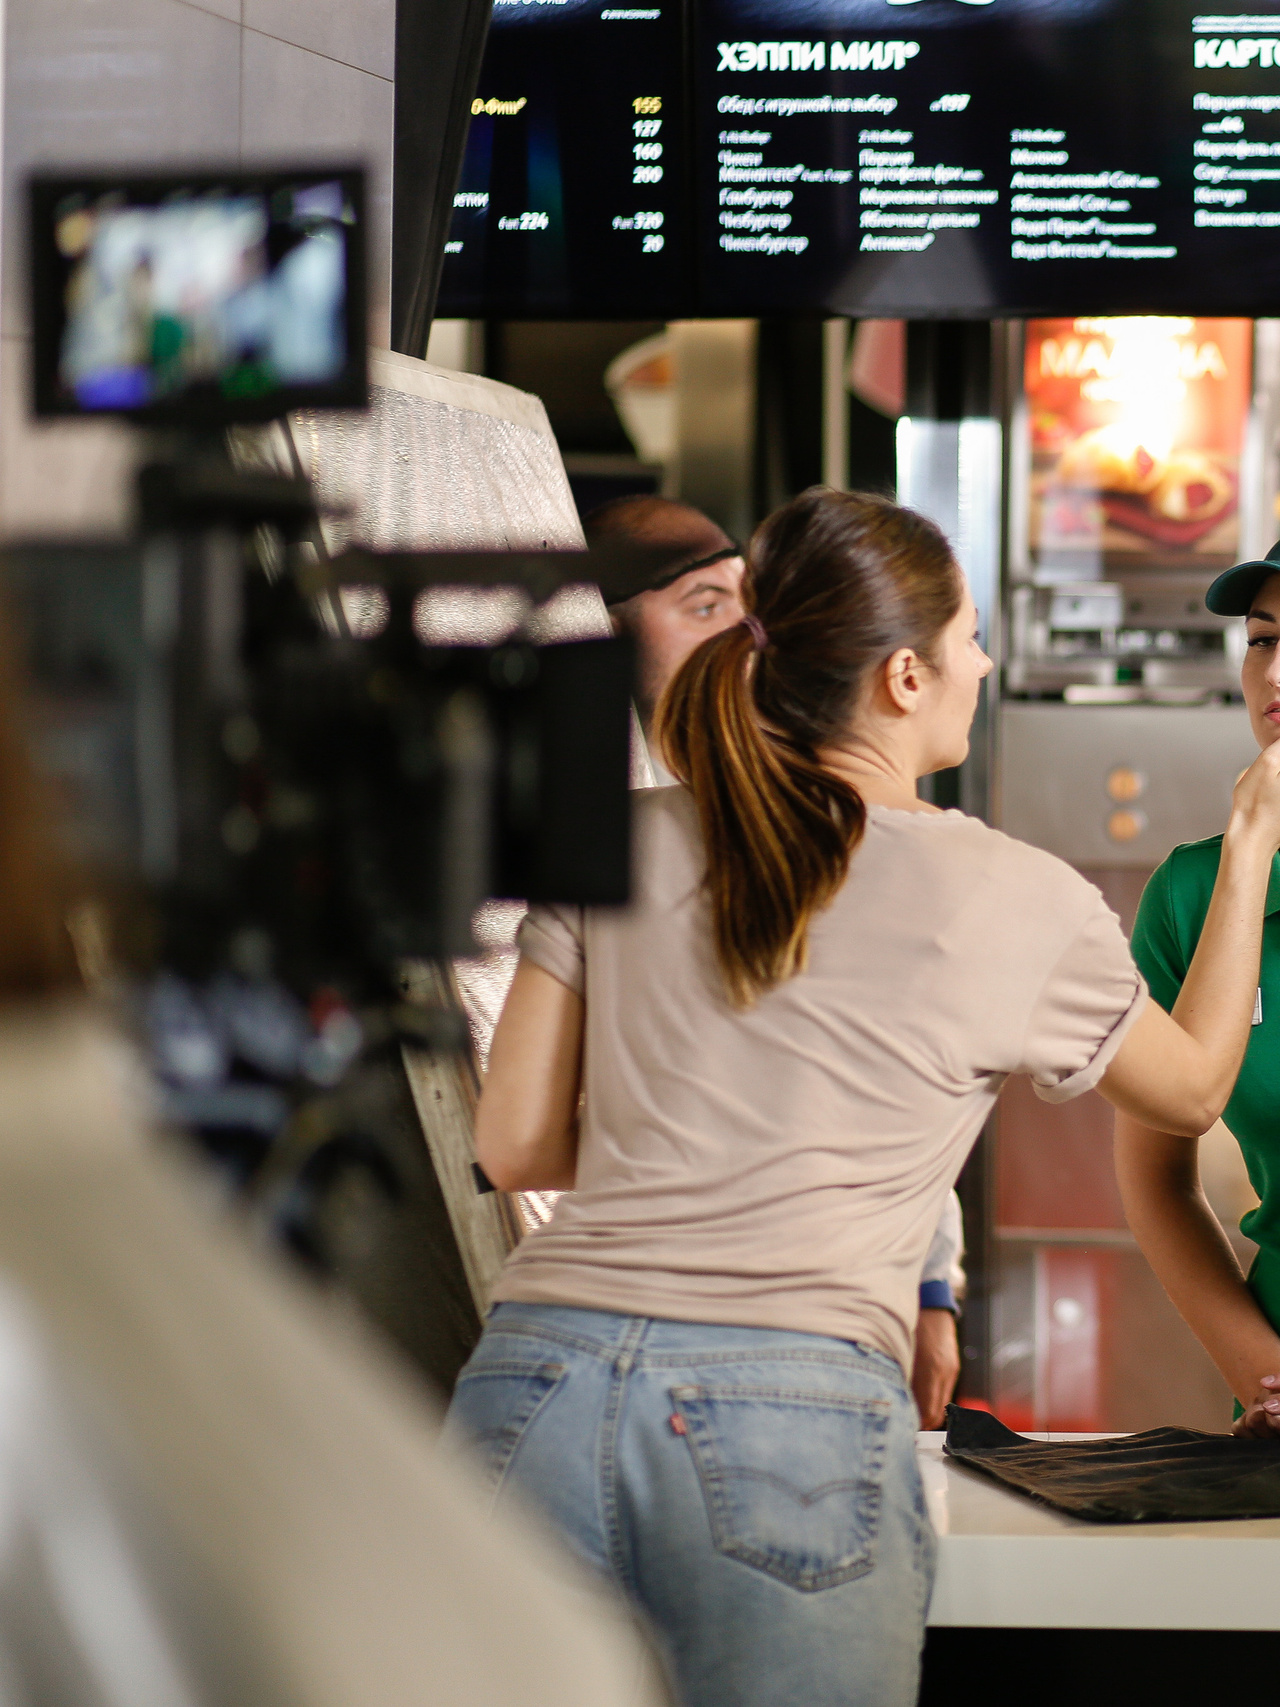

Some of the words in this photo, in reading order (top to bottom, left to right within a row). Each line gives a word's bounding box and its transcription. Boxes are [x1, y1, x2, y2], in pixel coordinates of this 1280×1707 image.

[717, 41, 826, 71] ХЭППИ
[632, 97, 662, 114] 155
[632, 120, 663, 137] 127
[633, 143, 663, 160] 160
[633, 166, 663, 183] 200
[519, 212, 549, 230] 224
[633, 212, 664, 230] 320
[642, 234, 664, 252] 20
